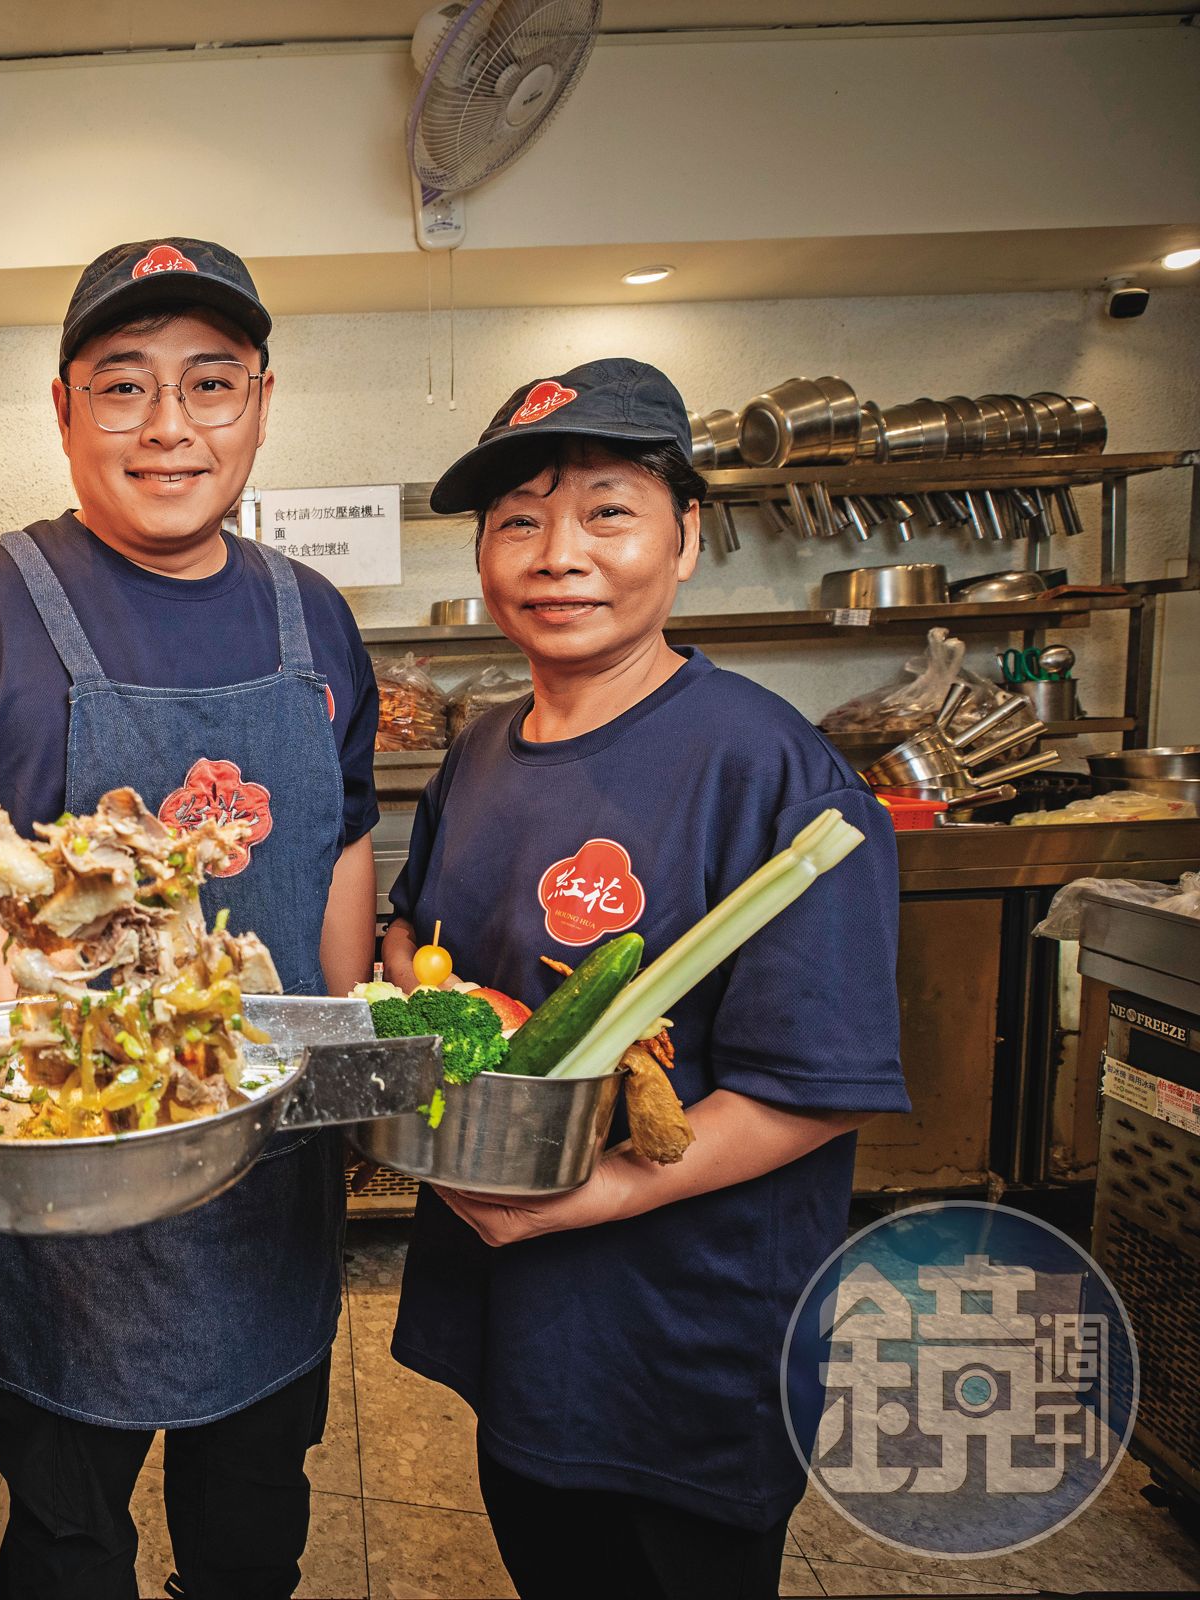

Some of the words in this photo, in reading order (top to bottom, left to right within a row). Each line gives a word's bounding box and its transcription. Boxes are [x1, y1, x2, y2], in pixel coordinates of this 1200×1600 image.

[274, 504, 386, 522] 食材請勿放壓縮機上
[274, 527, 287, 540] 面
[276, 541, 350, 557] 避免食物壞掉
[546, 866, 625, 914] 紅花
[580, 916, 597, 930] HUA
